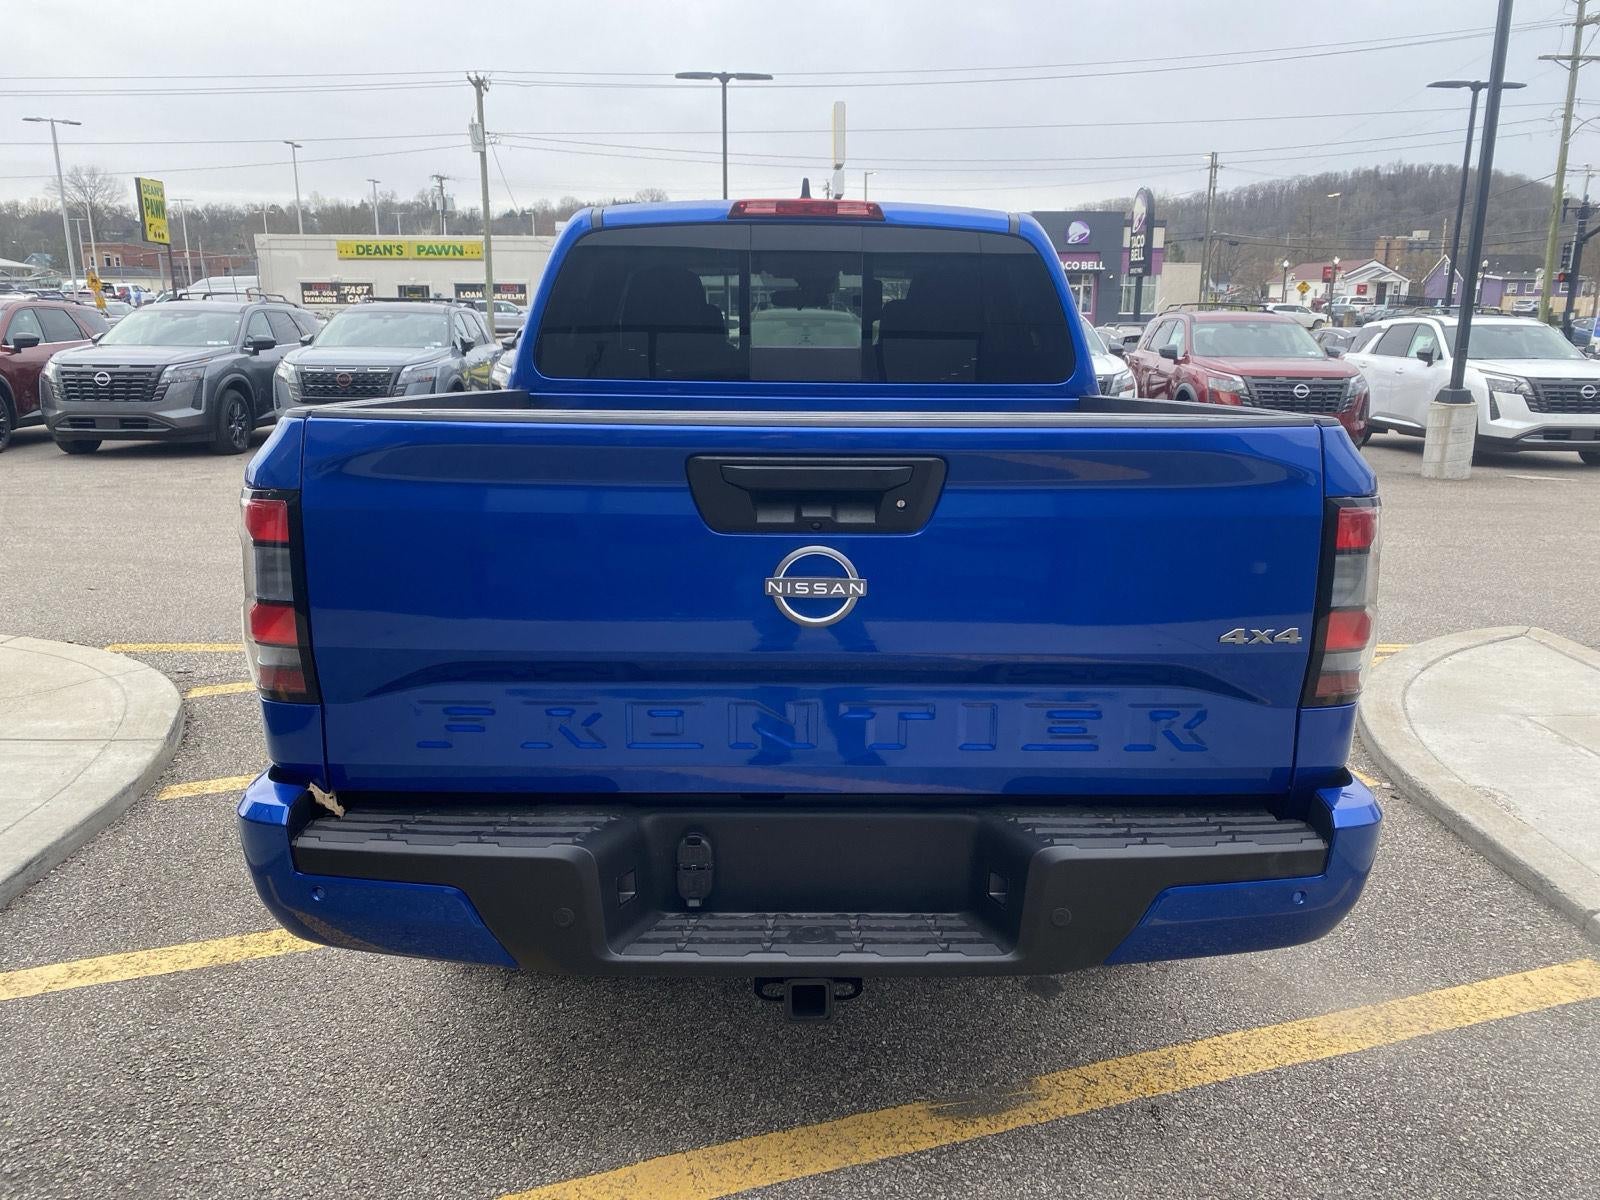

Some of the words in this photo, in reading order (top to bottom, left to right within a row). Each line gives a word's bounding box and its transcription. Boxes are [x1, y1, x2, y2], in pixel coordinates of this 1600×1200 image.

[143, 184, 164, 198] DEAN'S
[144, 197, 166, 220] PAWN
[1131, 235, 1145, 248] TACO
[356, 244, 403, 256] DEAN'S
[416, 244, 464, 256] PAWN
[1130, 248, 1144, 261] BELL
[1060, 261, 1080, 270] ACO
[1081, 261, 1106, 270] BELL
[344, 285, 369, 294] FAST
[767, 581, 864, 595] NISSAN
[412, 700, 1209, 752] FRONTIER
